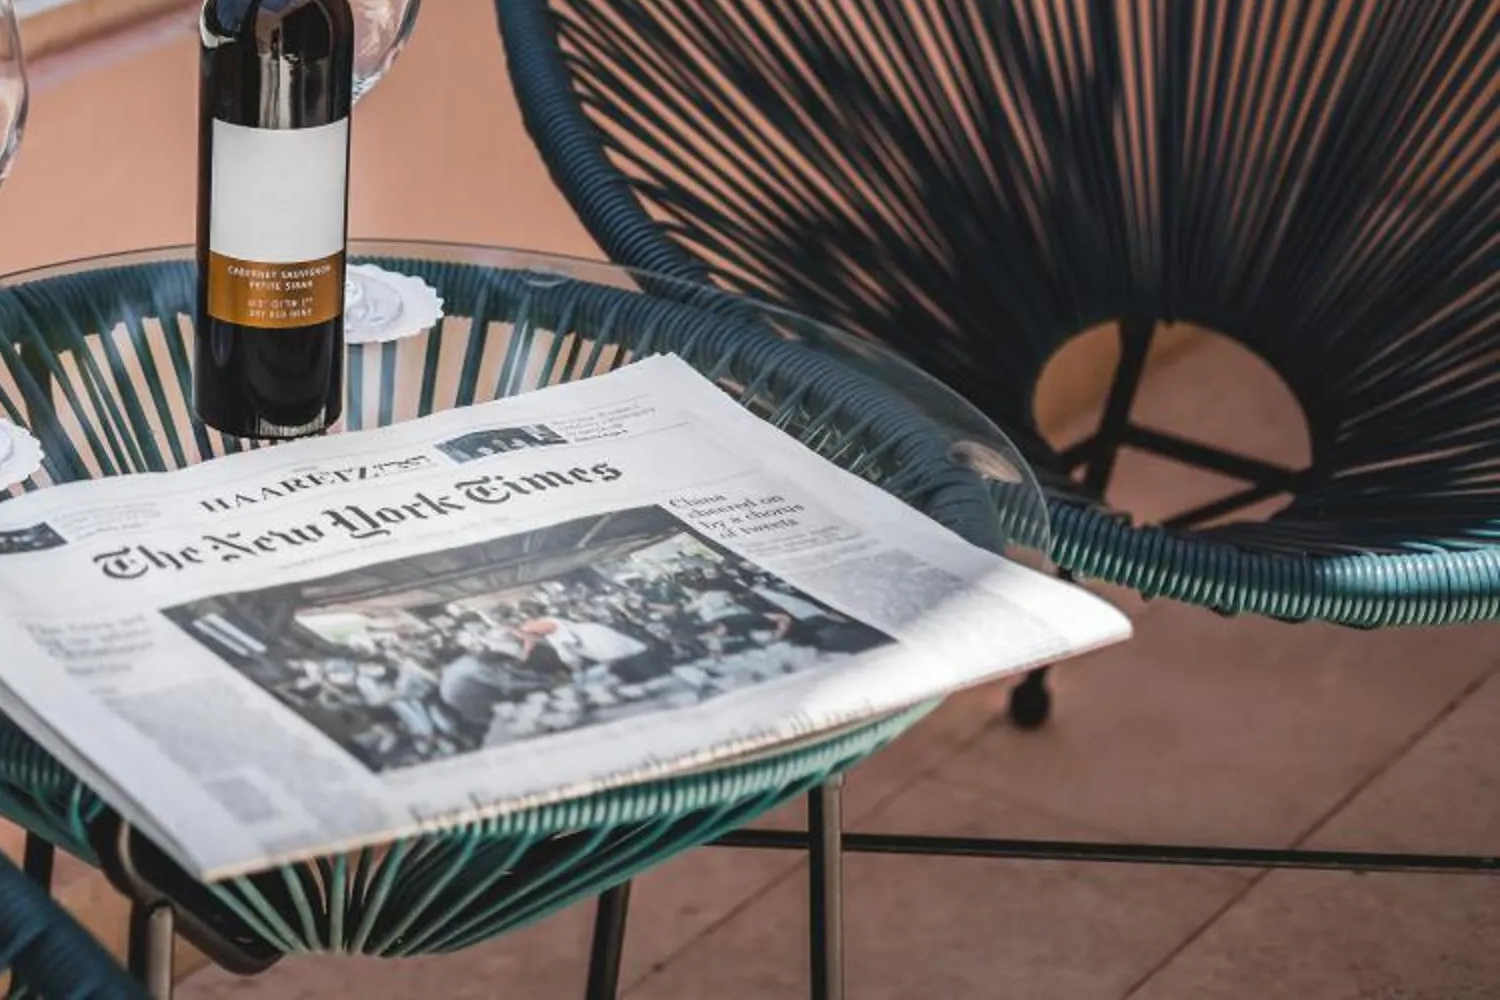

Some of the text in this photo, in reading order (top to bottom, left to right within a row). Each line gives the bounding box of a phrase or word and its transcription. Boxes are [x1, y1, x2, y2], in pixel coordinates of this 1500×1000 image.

[227, 264, 331, 279] CABERNET SAUVIGNON
[200, 464, 375, 512] HAARETZ
[759, 495, 786, 505] on
[92, 543, 202, 580] The
[197, 521, 325, 563] New
[322, 491, 467, 540] York
[453, 461, 624, 504] Times
